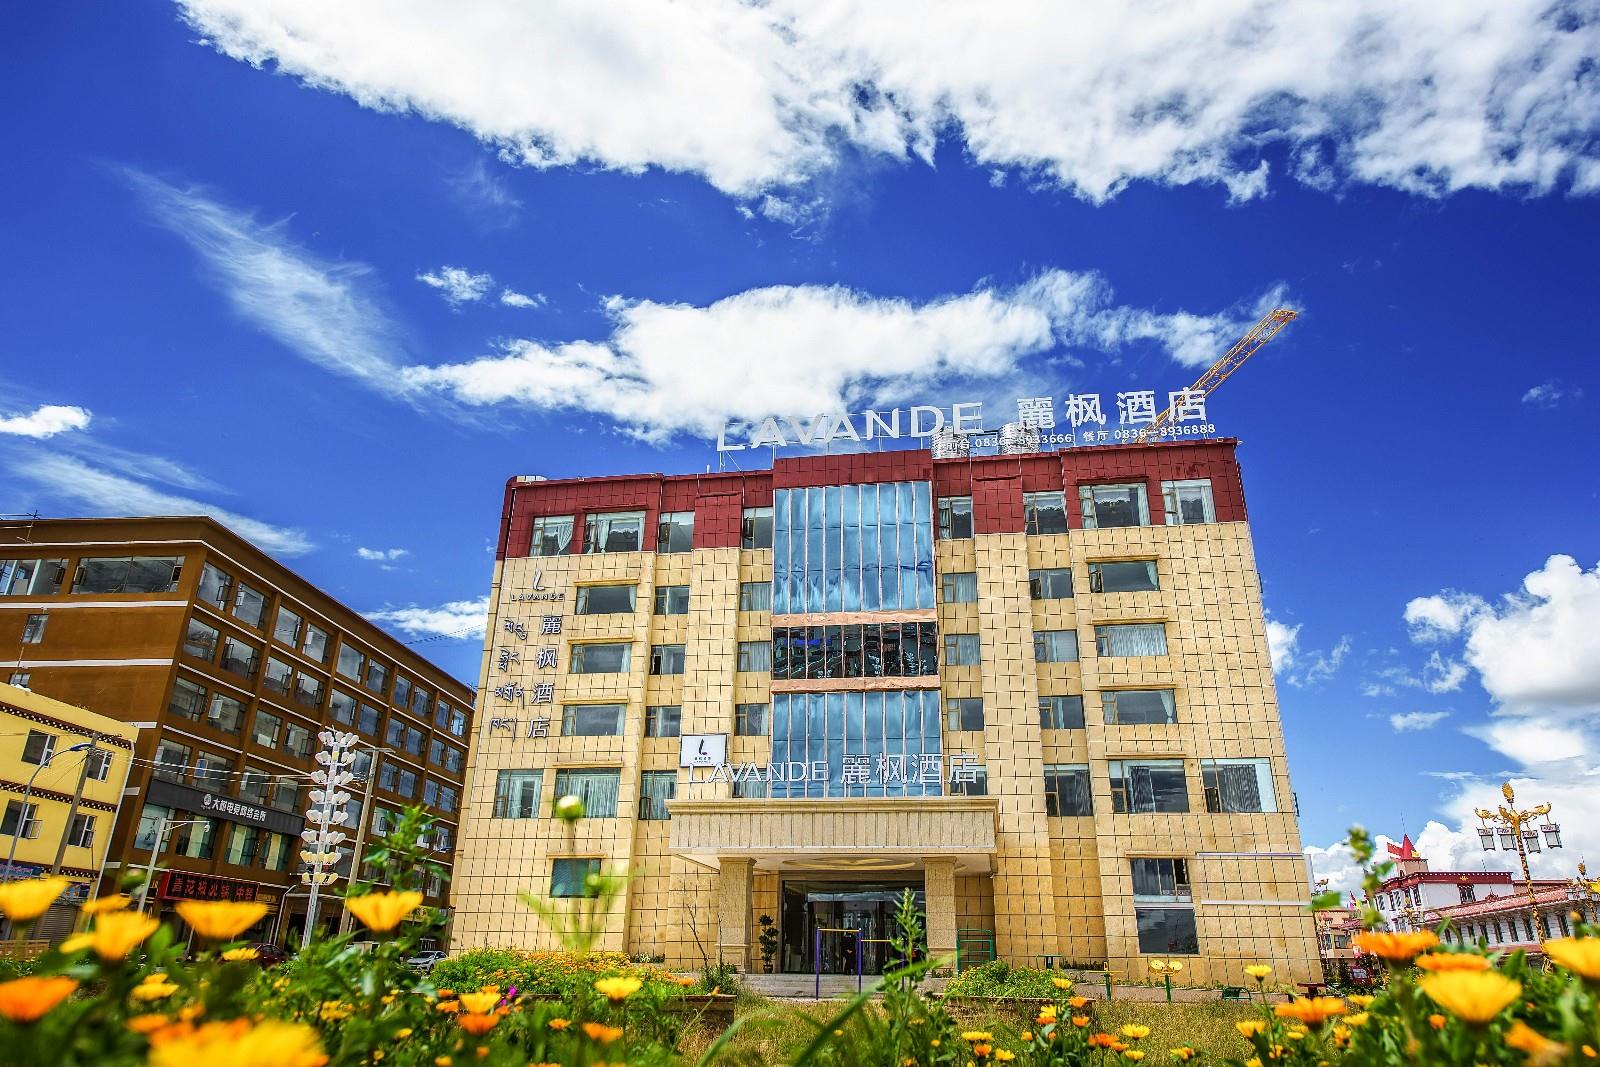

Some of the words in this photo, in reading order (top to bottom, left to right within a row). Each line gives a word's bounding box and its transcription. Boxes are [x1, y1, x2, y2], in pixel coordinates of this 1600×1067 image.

[1016, 386, 1207, 430] 麗枫酒店
[716, 401, 984, 452] LAVANDE
[1083, 430, 1108, 442] 餐厅
[511, 593, 565, 601] LAVANDE
[527, 615, 563, 738] 麗枫酒店
[688, 761, 829, 784] LAVANDE
[840, 752, 979, 785] 麗枫酒店
